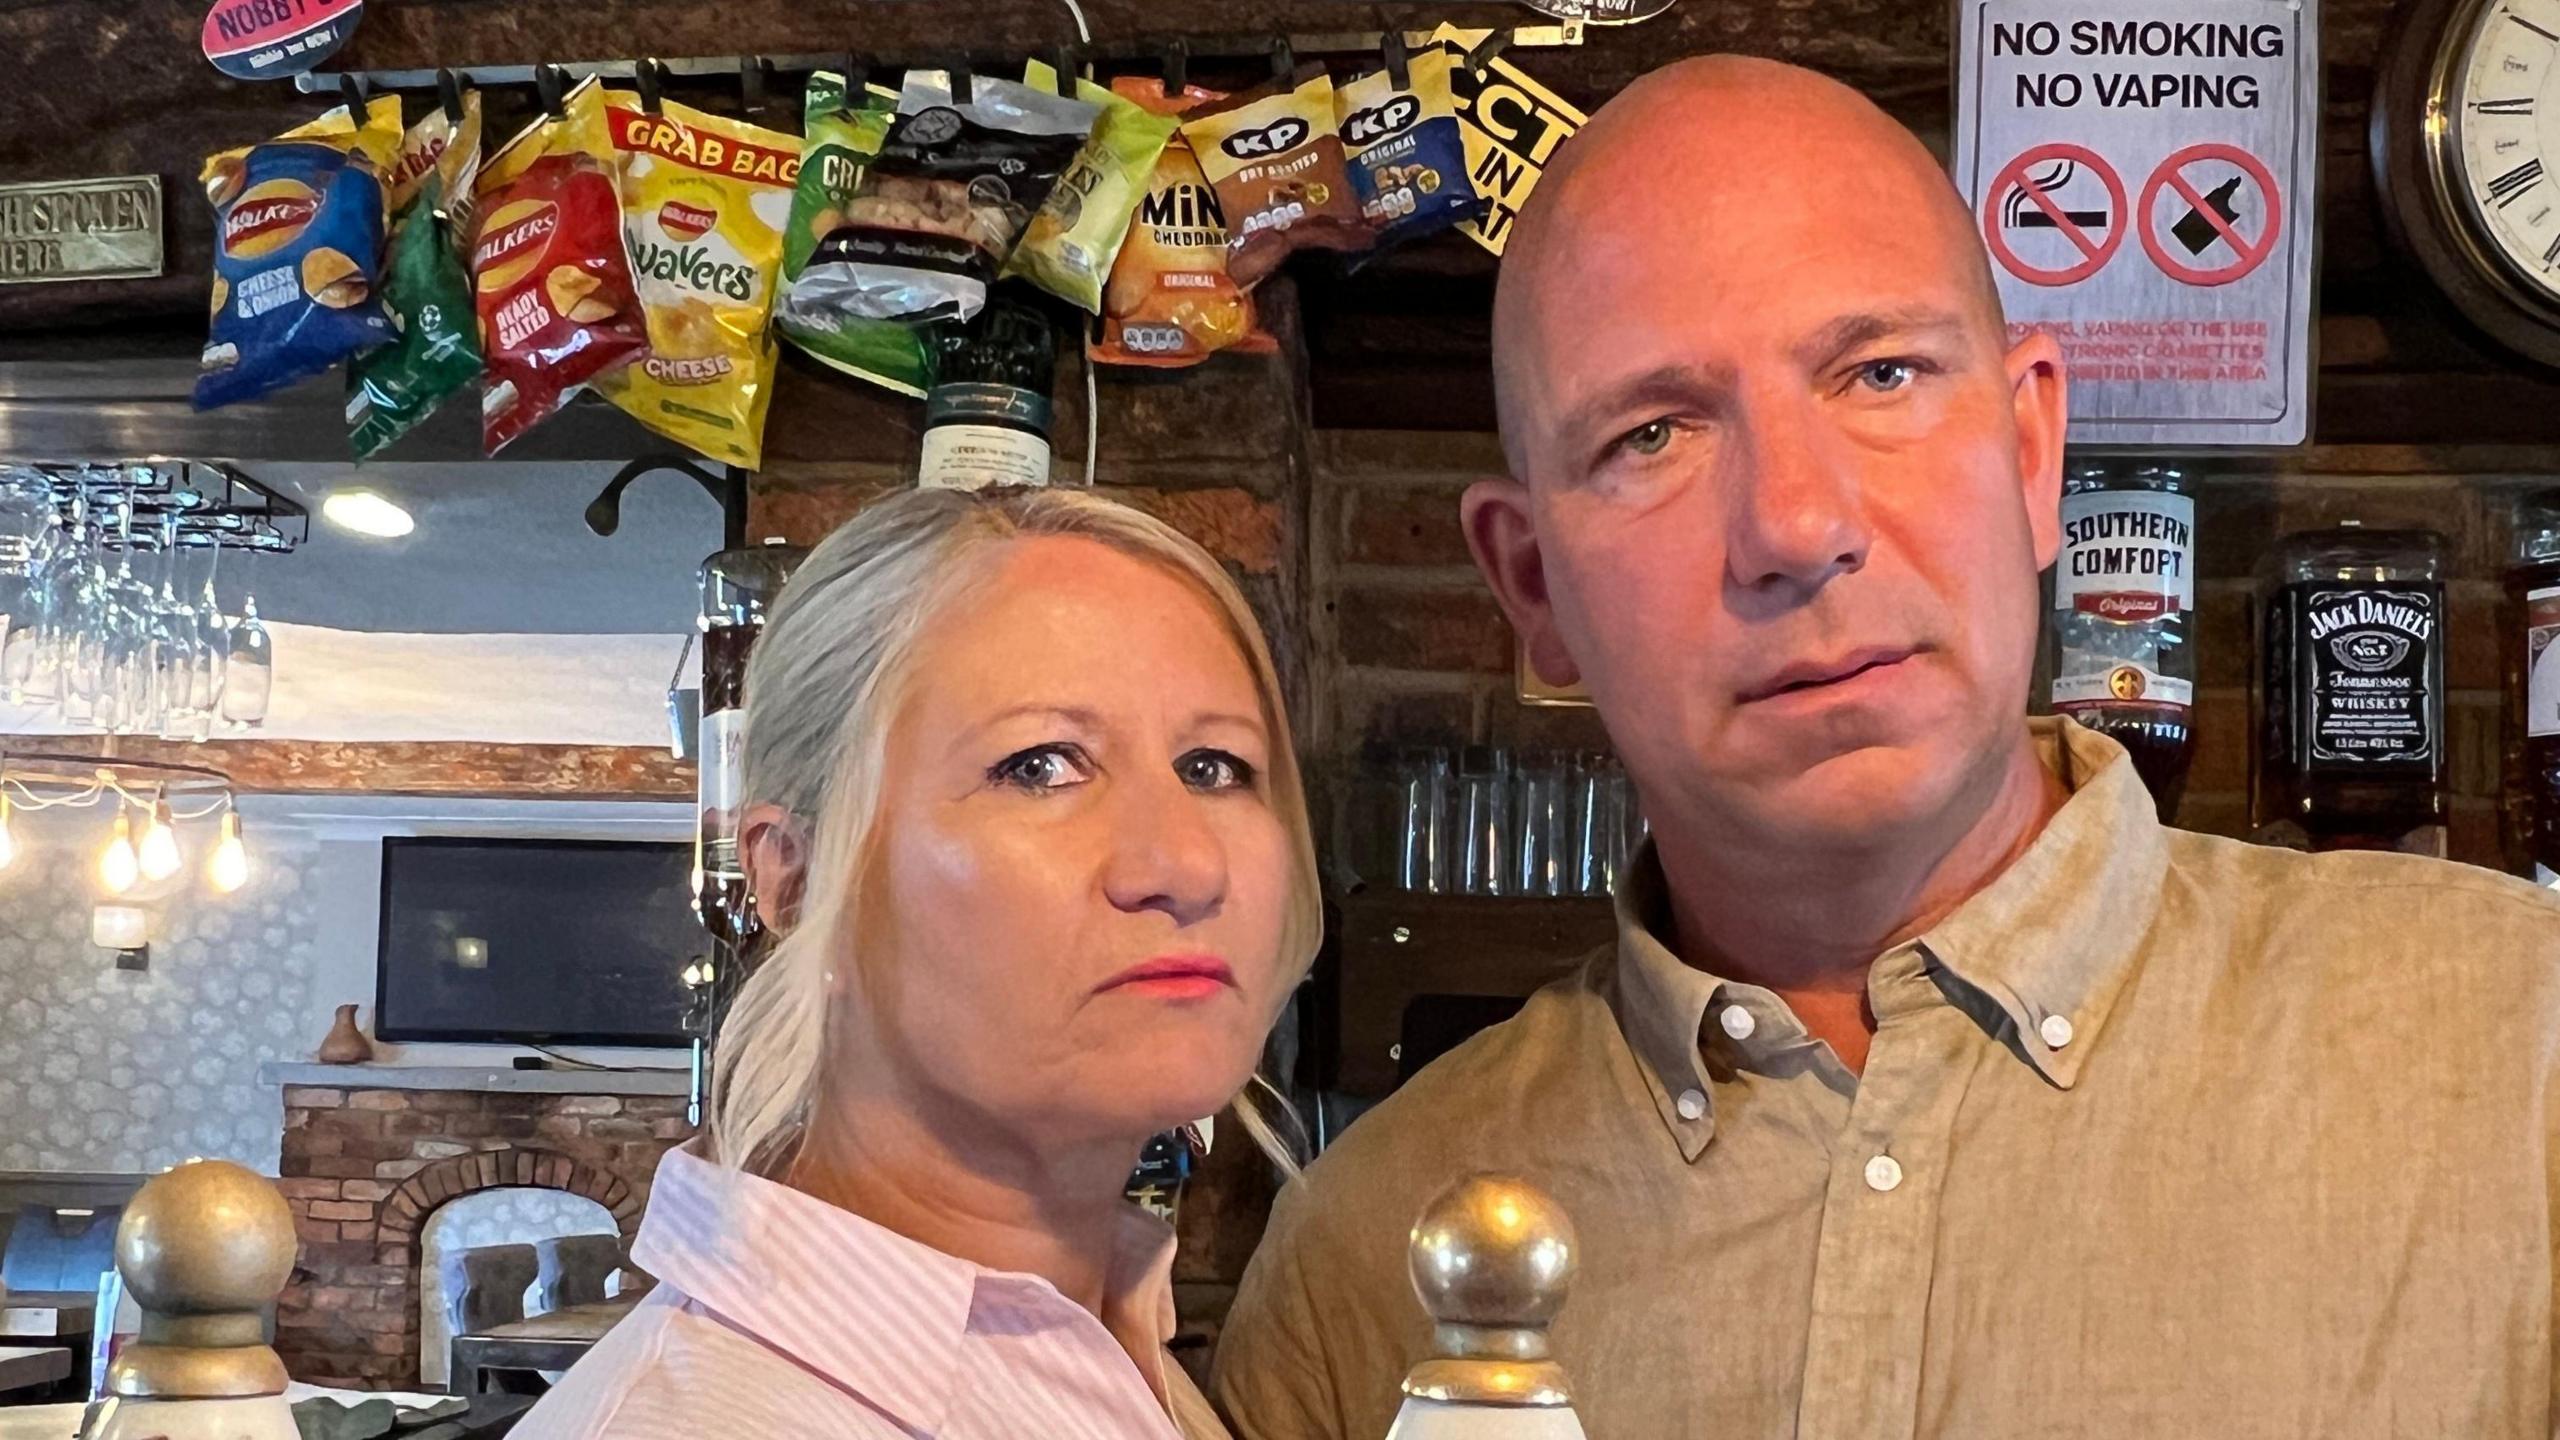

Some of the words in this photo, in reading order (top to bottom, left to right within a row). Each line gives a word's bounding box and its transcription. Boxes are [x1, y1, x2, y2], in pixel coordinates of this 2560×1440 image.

[1993, 21, 2060, 56] NO
[2070, 20, 2284, 58] SMOKING
[2016, 73, 2082, 108] NO
[2093, 73, 2260, 109] VAPING
[1232, 123, 1300, 155] KP
[1350, 101, 1412, 141] KP
[626, 120, 725, 167] GRAB
[1360, 134, 1417, 166] ORIGINAL
[1473, 146, 1525, 198] IN
[1142, 184, 1226, 229] MiN
[475, 213, 555, 263] ALKERS
[1154, 231, 1231, 247] CHEDDAR
[629, 229, 756, 301] uavers
[495, 287, 539, 331] READY
[499, 305, 551, 350] SALTED
[645, 355, 732, 379] CHEESE
[2066, 511, 2189, 549] SOUTHERN
[2072, 547, 2182, 578] COMFORT
[2308, 603, 2358, 640] JACK
[2331, 697, 2411, 710] WHISKEY
